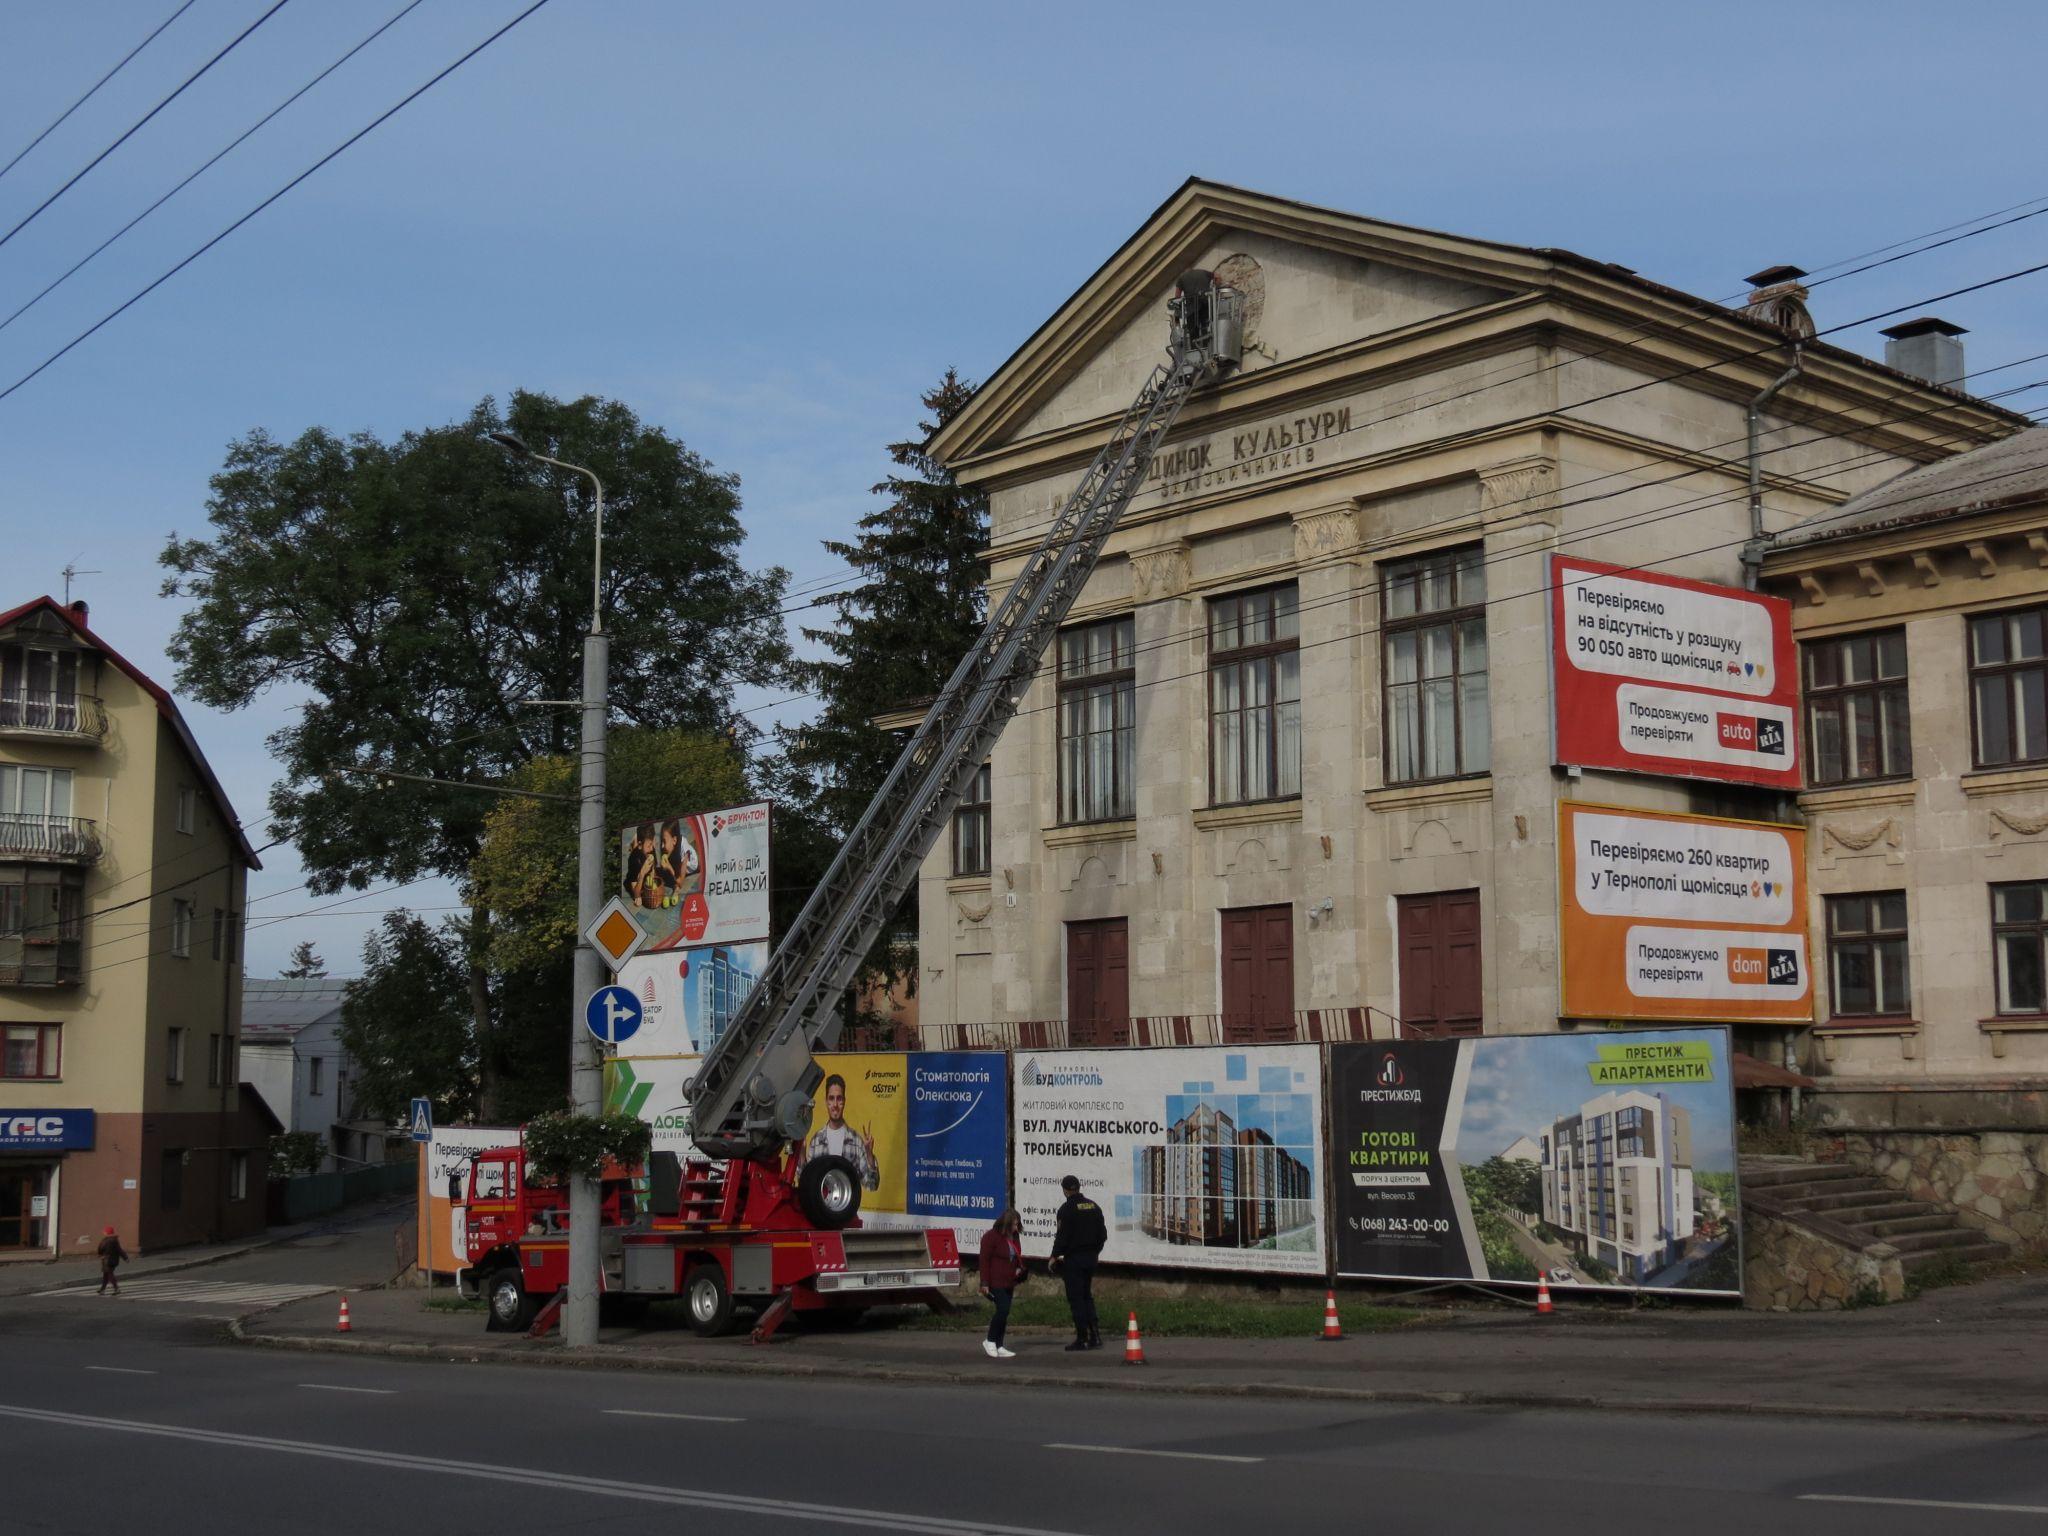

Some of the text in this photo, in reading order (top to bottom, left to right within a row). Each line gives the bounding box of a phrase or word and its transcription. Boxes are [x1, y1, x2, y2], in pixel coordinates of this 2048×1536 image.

[1149, 406, 1352, 481] ДИНОК КУЛЬТУРИ
[1577, 586, 1665, 616] Перевіряємо
[1578, 613, 1742, 655] на відсутність у розшуку
[1578, 636, 1723, 673] 90 050 авто щомісяця
[1629, 702, 1709, 724] Продовжуємо
[1631, 724, 1694, 743] перевіряти
[1722, 723, 1783, 747] auto RIA
[715, 858, 737, 875] МРІЙ
[745, 855, 760, 872] ДІЙ
[1590, 839, 1770, 875] Перевіряємо 260 квартир
[709, 870, 768, 896] РЕАЛІЗУЙ
[1591, 869, 1748, 898] у Тернополі щомісяця
[1638, 944, 1719, 964] Продовжуємо
[1639, 966, 1704, 984] перевіряти
[1732, 953, 1795, 980] dom RIA
[643, 1005, 662, 1014] ЕАТОР
[1625, 1045, 1684, 1059] ПРЕСТИЖ
[915, 1067, 990, 1083] Стоматологія
[1035, 1073, 1103, 1087] БУДКОНТРОЛЬ
[1599, 1063, 1705, 1080] АПАРТАМЕНТИ
[915, 1087, 972, 1102] Олексюка
[1361, 1089, 1422, 1103] ПРЕСТИЖБУД
[1022, 1099, 1125, 1111] ЖИТЛОВИЙ КОМПЛЕКС ПО
[1023, 1119, 1164, 1135] ВУЛ. ЛУЧАКІВСЬКОГО-
[1361, 1131, 1415, 1147] ГОТОВІ
[1023, 1140, 1113, 1158] ТРОЛЕЙБУСНА
[1350, 1150, 1430, 1166] КВАРТИРИ
[1029, 1177, 1104, 1187] цегляни динок
[1361, 1175, 1383, 1183] ПОРУЧ
[1390, 1175, 1421, 1184] ЦЕНТРОМ
[915, 1193, 995, 1209] ІМПЛАНТАЦІЯ ЗУБІВ
[1407, 1191, 1416, 1201] 35
[1040, 1207, 1057, 1215] вул.К
[1361, 1217, 1449, 1232] (068) 243-00-00
[963, 1229, 987, 1247] ЗДОР
